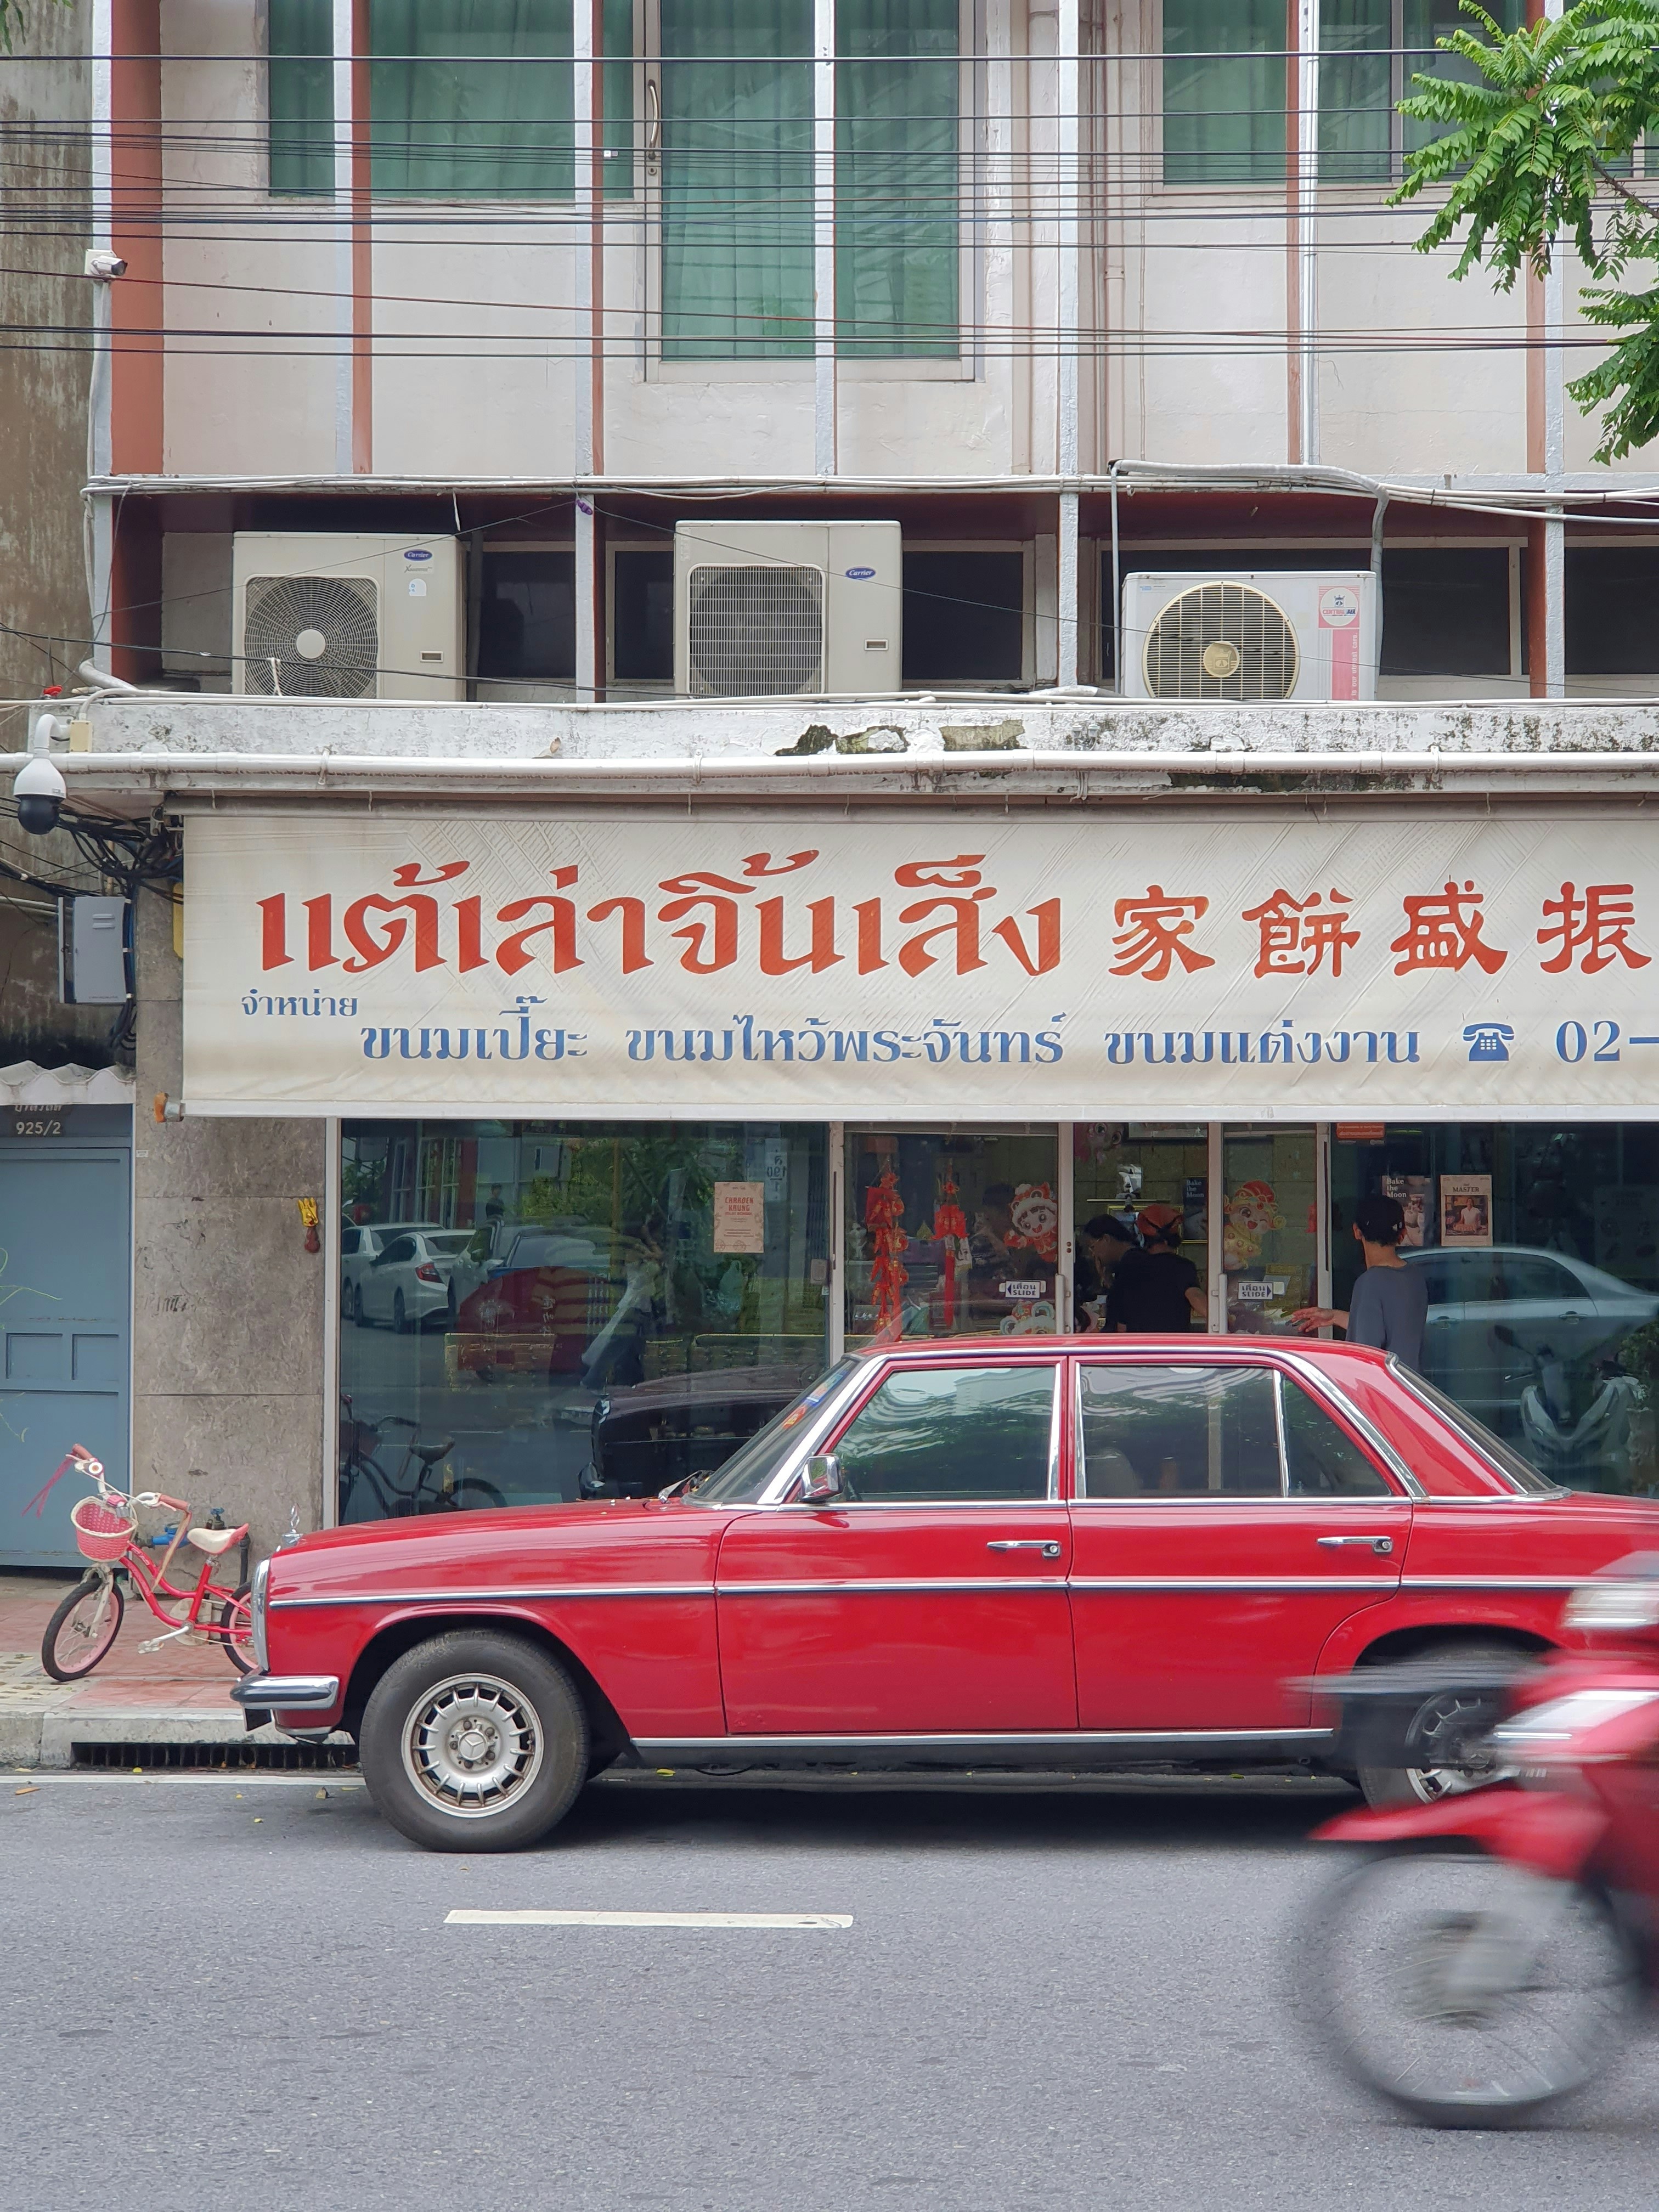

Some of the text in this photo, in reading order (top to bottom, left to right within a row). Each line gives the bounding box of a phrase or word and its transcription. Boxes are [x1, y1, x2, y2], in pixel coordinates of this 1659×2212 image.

[256, 849, 1061, 978] แต้เล่าจิ้นเส็ง
[241, 989, 358, 1017] จำหน่าย
[361, 996, 588, 1060] ขนมเปี๊ยะ
[626, 1012, 1066, 1063] ขนมไหว้พระจันทร์
[1104, 1019, 1420, 1064] ขนมแต่งงาน
[15, 1120, 61, 1136] 925/2
